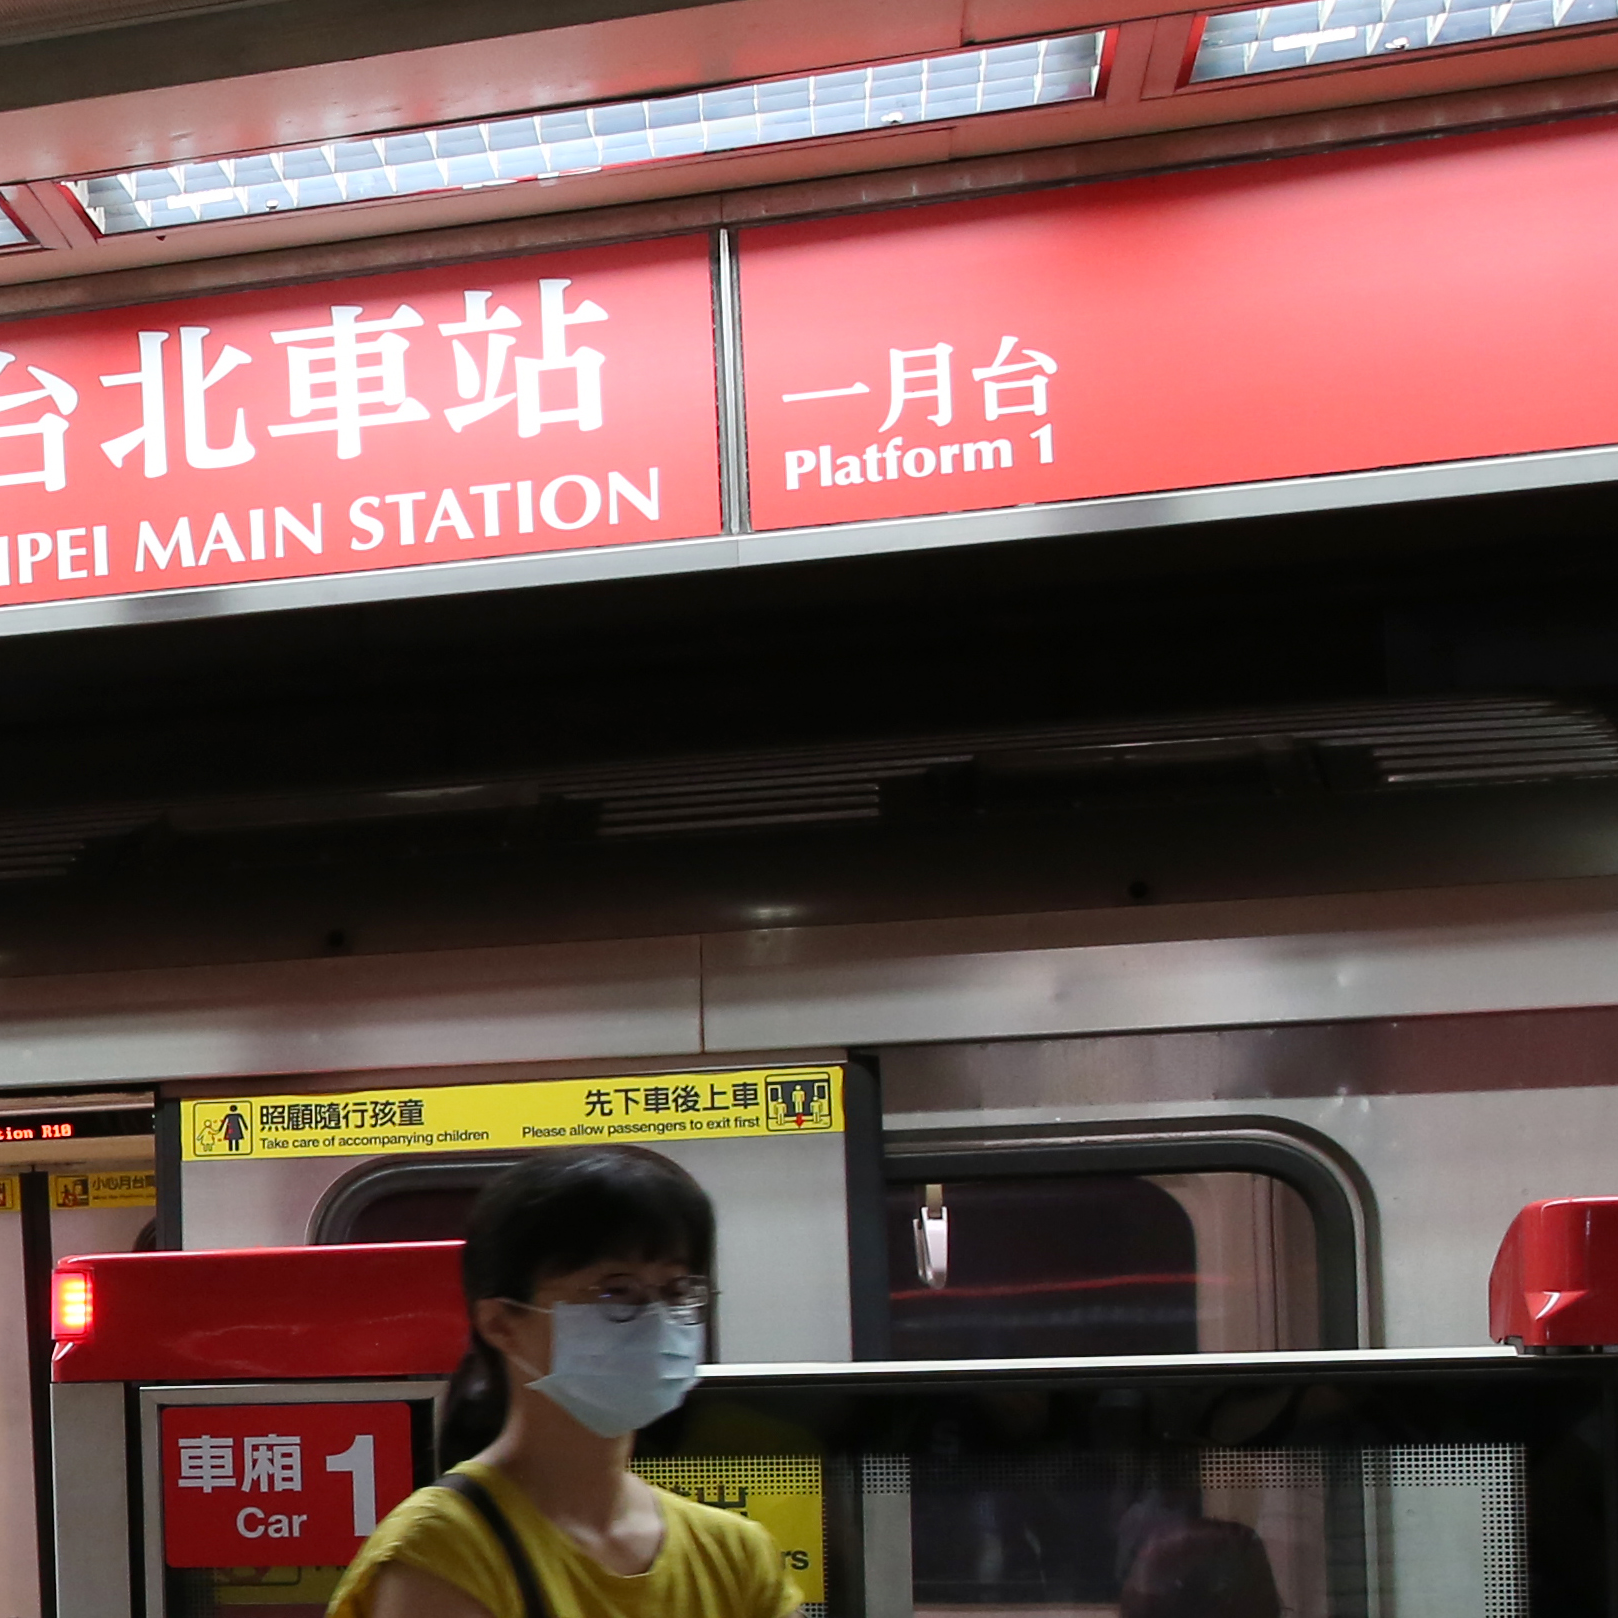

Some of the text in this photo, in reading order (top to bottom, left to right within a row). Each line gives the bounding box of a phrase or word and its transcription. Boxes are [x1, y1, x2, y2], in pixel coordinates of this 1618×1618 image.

[781, 335, 1059, 433] 一月台
[783, 423, 1056, 491] Platform 1
[134, 500, 324, 575] MAIN
[347, 467, 661, 551] STATION
[259, 1098, 425, 1132] 照顧隨行孩童
[584, 1081, 760, 1117] 先下車後上車
[41, 1123, 72, 1138] R10
[260, 1129, 490, 1150] Take care of accompanying children
[522, 1115, 761, 1139] Please allow passengers to exit first
[177, 1434, 303, 1493] 車廂
[326, 1434, 377, 1537] 1
[236, 1506, 308, 1539] Car
